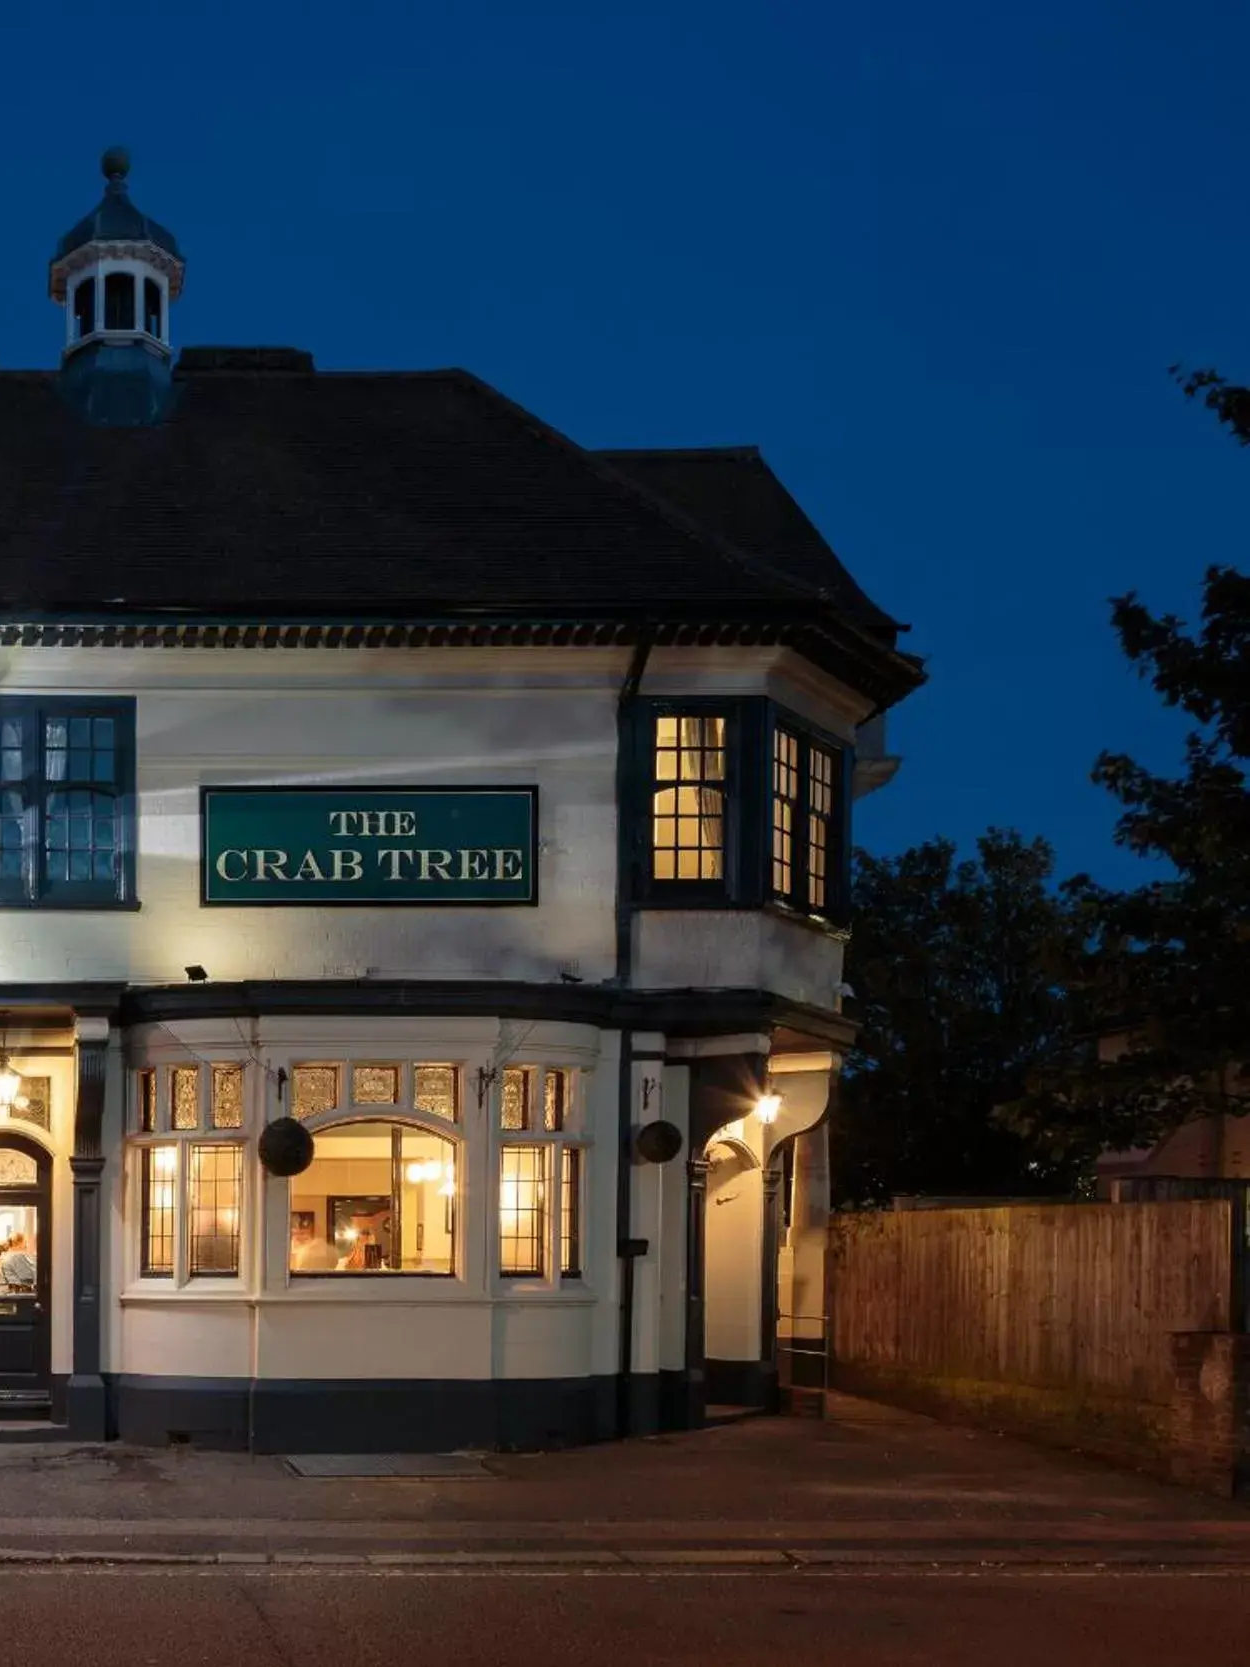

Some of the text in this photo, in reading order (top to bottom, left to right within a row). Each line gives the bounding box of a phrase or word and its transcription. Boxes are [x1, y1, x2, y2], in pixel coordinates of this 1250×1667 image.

[329, 811, 416, 836] THE
[216, 849, 523, 881] CRAB TREE
